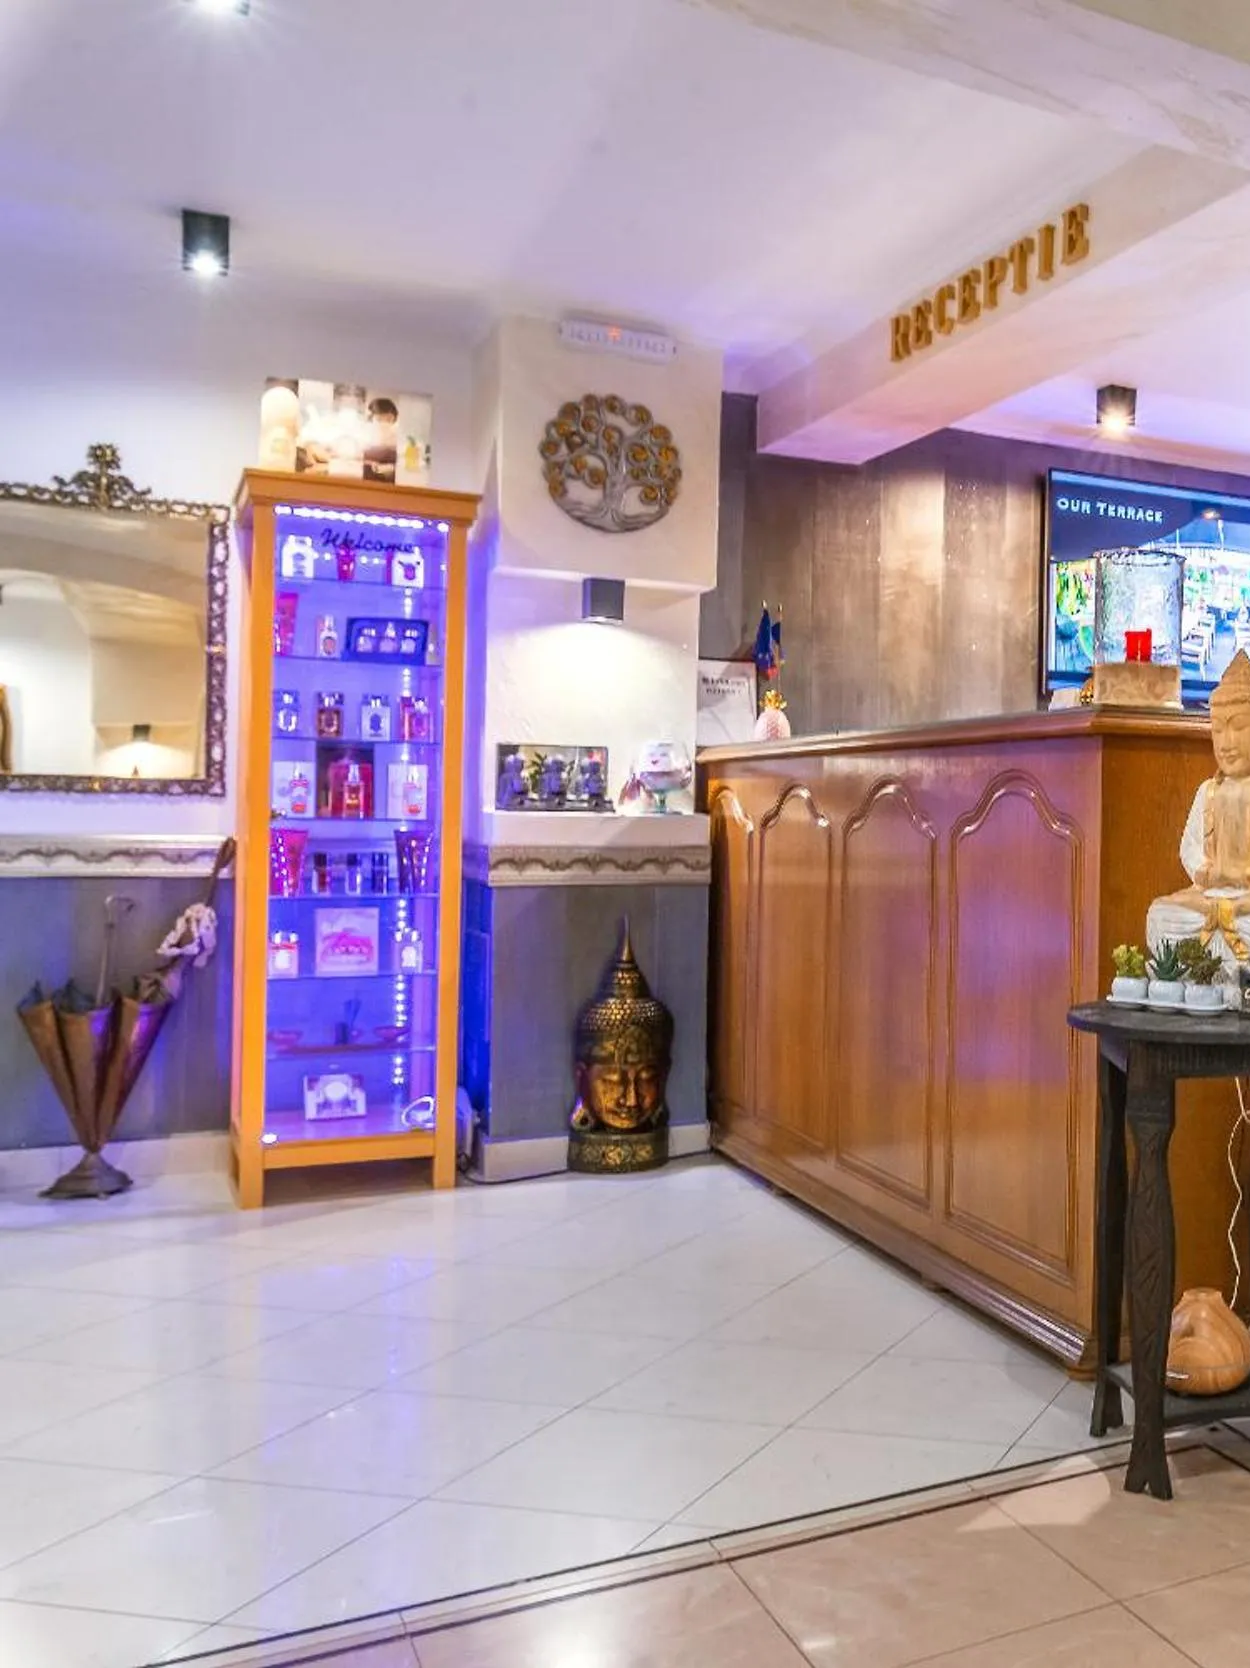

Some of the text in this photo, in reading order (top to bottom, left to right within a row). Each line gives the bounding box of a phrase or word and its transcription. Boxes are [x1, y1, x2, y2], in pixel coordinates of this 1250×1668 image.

[890, 203, 1090, 363] RECEPTIE
[1056, 497, 1163, 524] OUR TERRACE
[320, 528, 415, 554] Welcome
